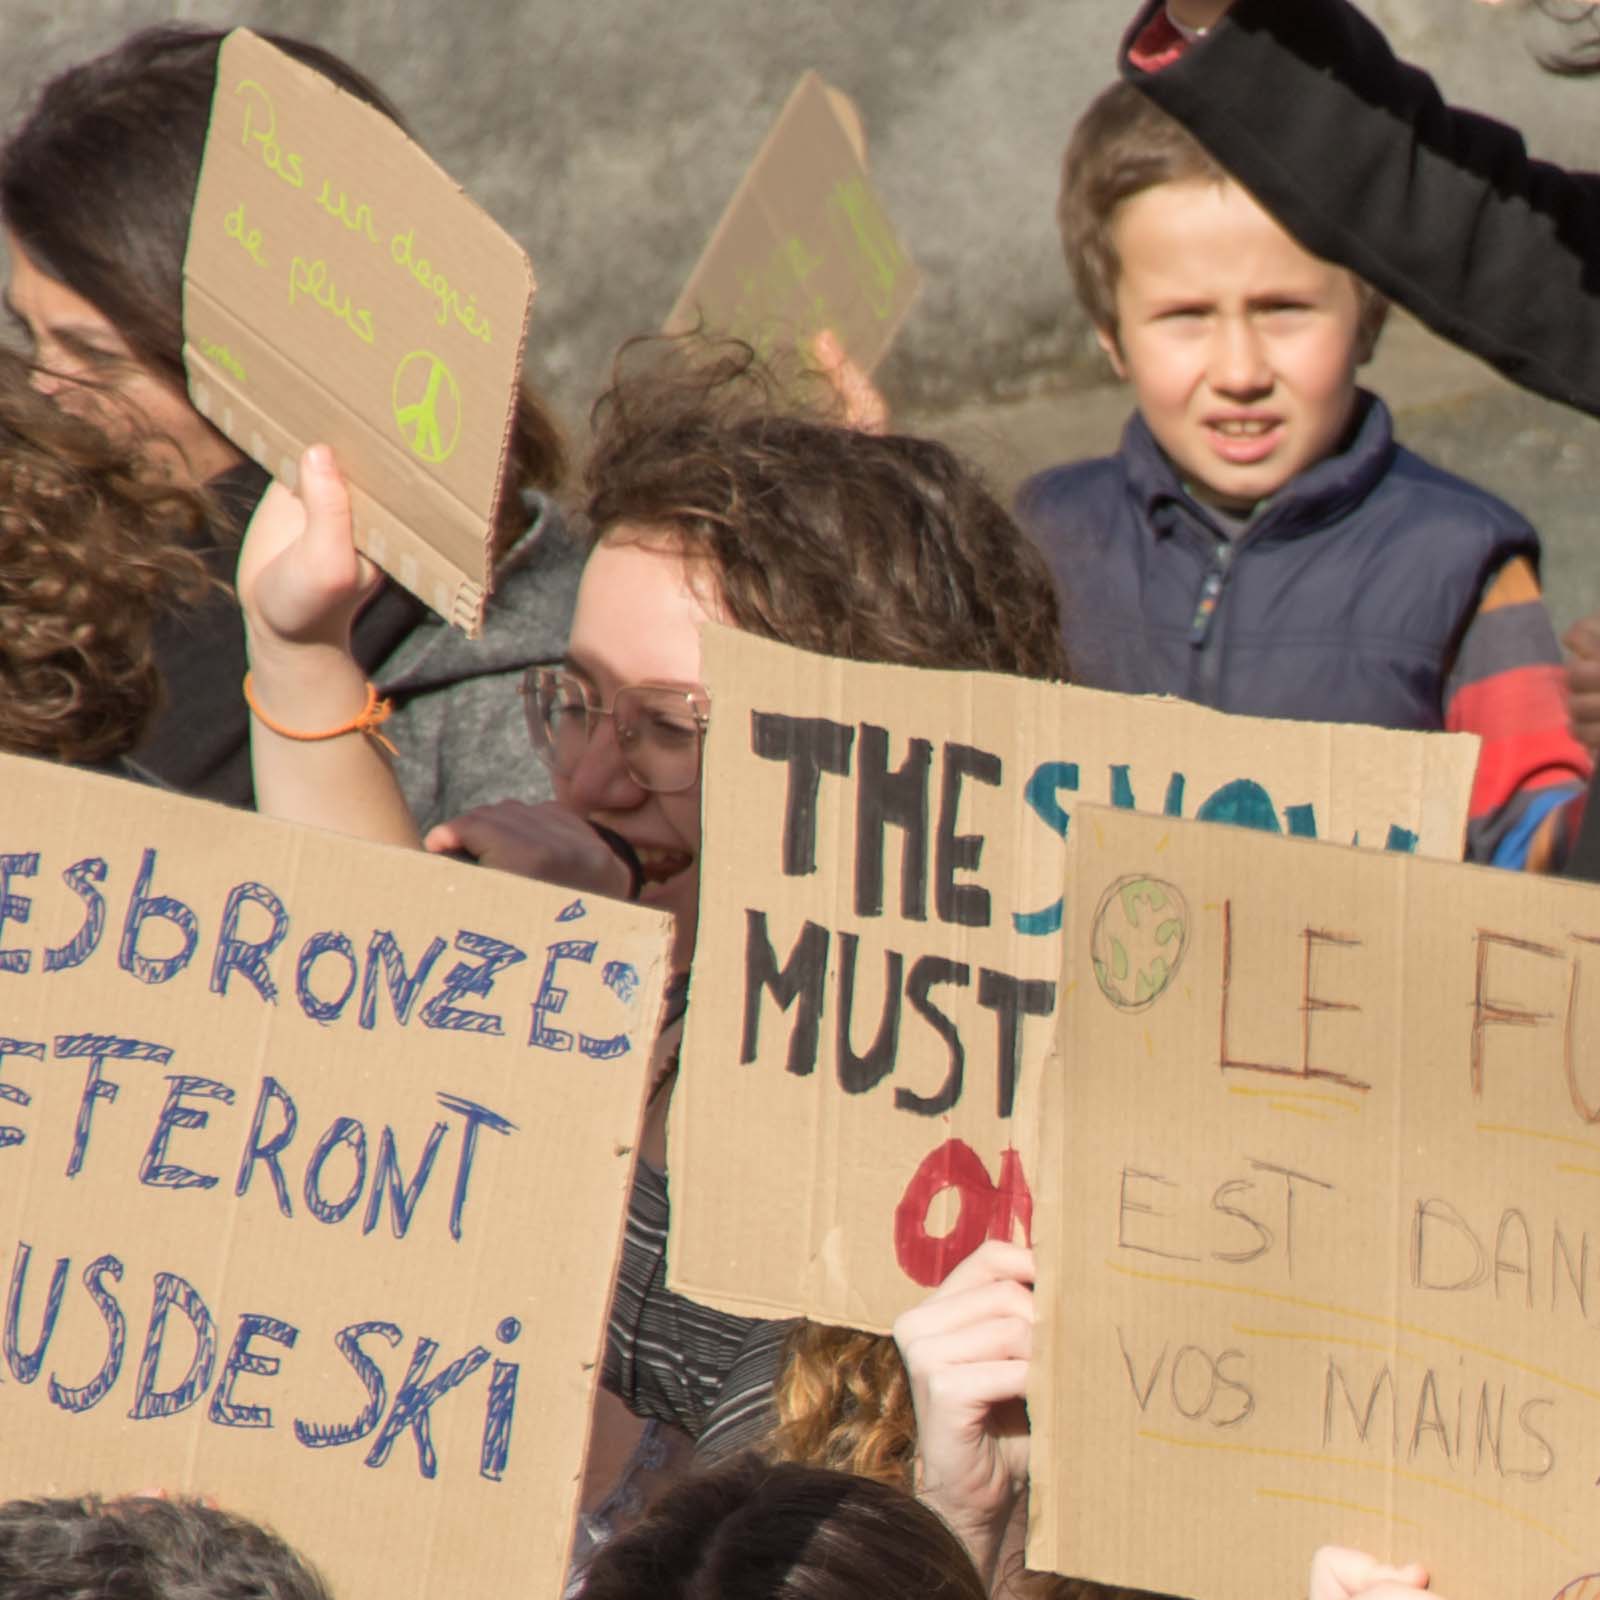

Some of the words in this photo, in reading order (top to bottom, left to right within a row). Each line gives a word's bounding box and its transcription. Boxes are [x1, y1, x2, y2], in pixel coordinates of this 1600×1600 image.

[234, 79, 304, 188] Pas
[316, 179, 379, 244] un
[223, 202, 270, 268] de
[289, 256, 375, 344] plus
[751, 708, 1002, 927] THE
[739, 907, 1057, 1119] MUST
[1221, 899, 1372, 1093] LE
[1118, 1156, 1335, 1281] EST
[1116, 1325, 1256, 1429] VOS
